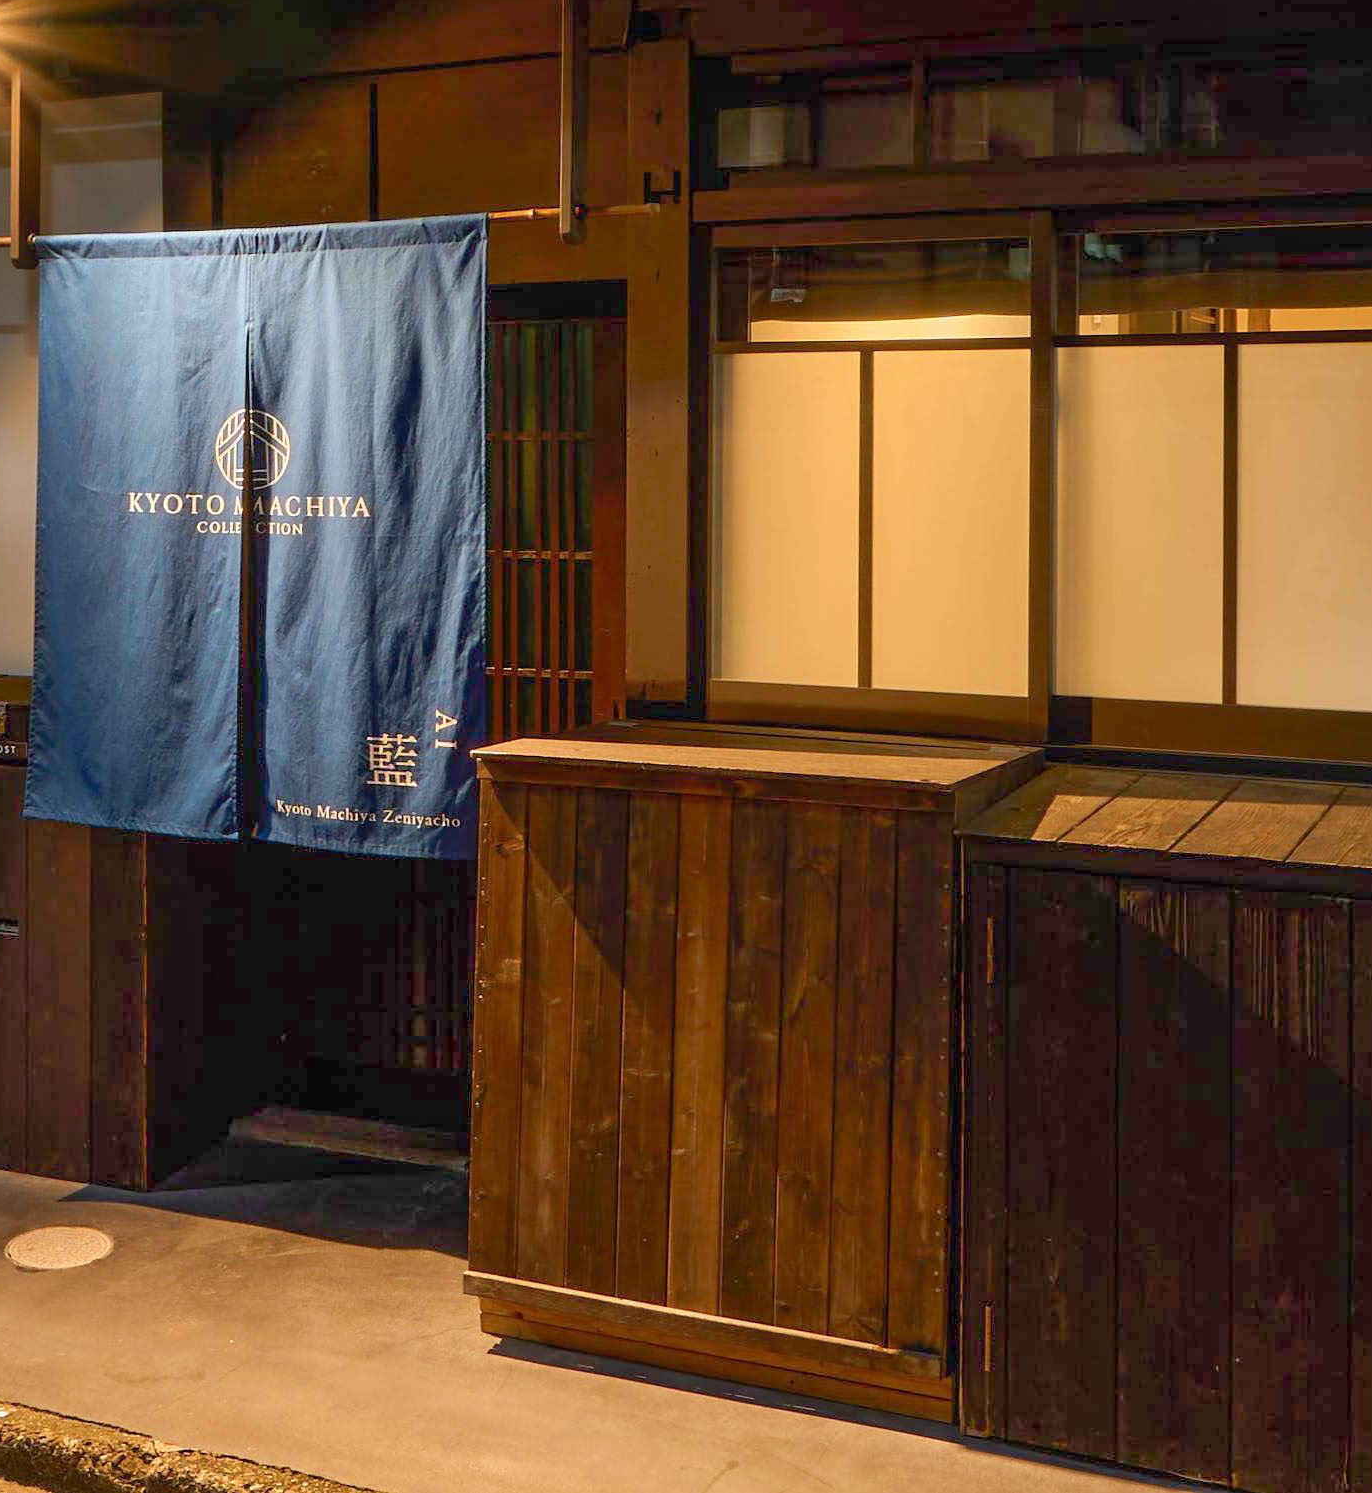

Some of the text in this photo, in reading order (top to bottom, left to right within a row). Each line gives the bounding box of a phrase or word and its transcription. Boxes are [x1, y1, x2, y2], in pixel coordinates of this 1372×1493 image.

[127, 492, 371, 518] KYOTO MACHIYA
[435, 708, 459, 750] AI
[366, 732, 418, 788] 藍
[276, 799, 461, 828] Kyoto Machiya Zeniyacho
